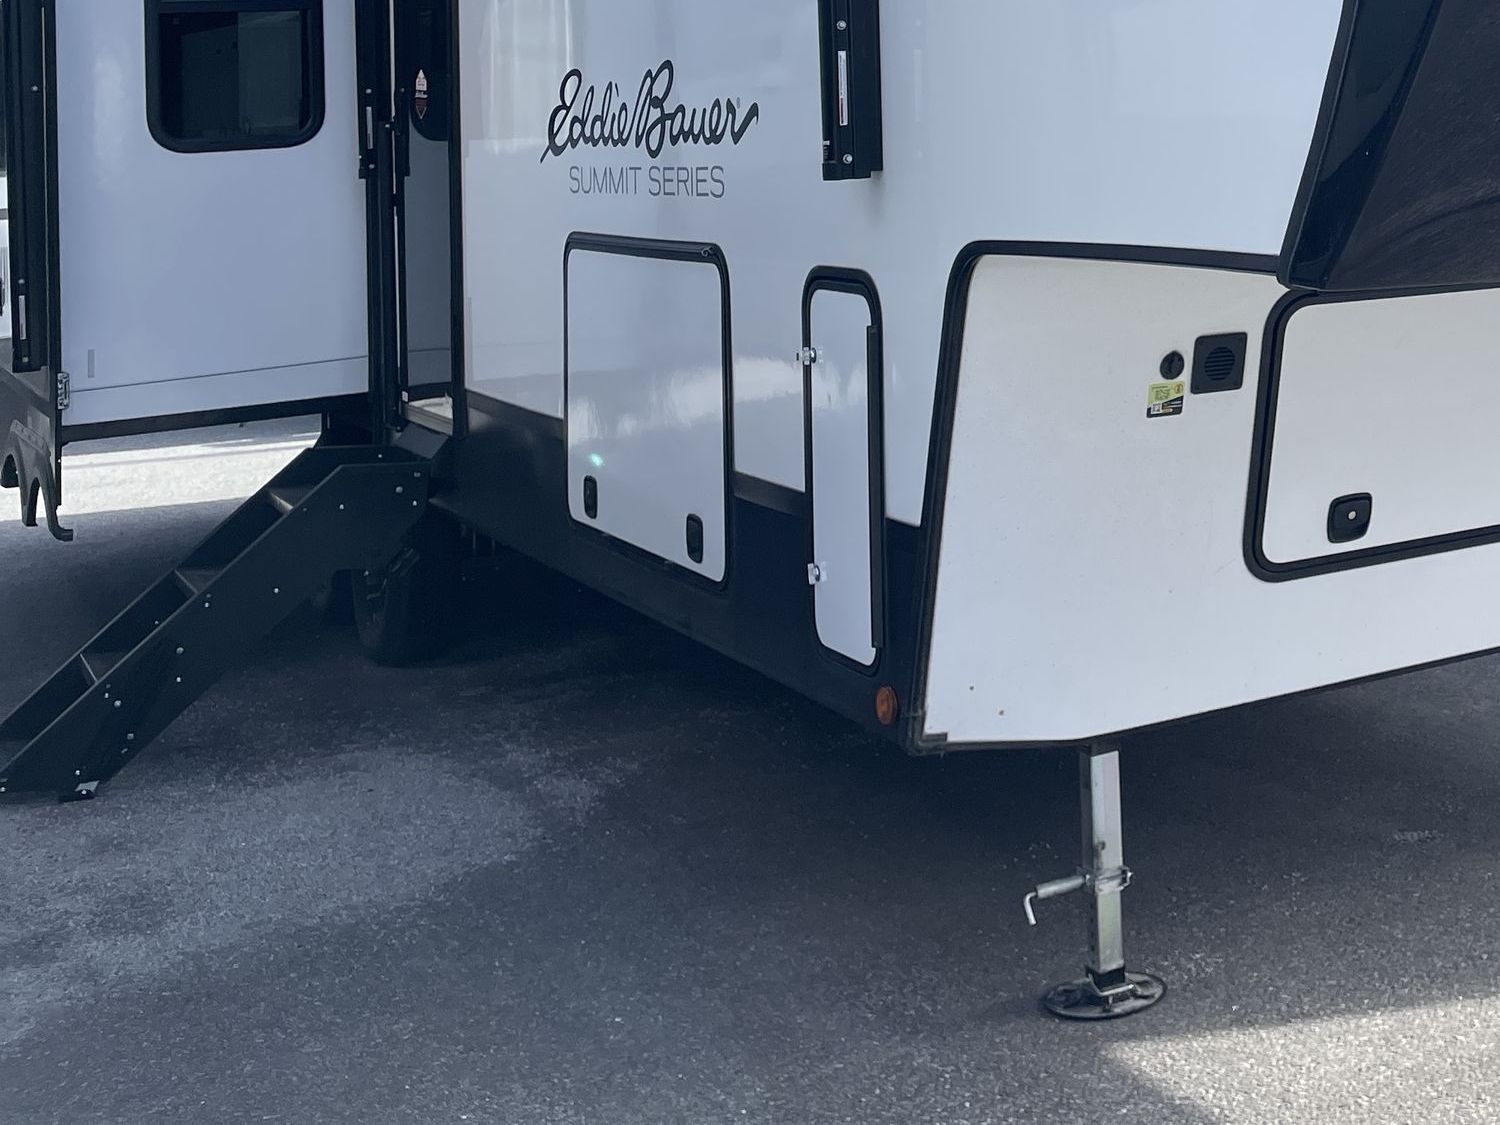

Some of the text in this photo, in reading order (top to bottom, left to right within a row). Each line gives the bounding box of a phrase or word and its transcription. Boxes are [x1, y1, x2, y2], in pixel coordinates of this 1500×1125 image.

[540, 68, 634, 163] Eddie
[632, 59, 759, 158] Bauer
[568, 165, 725, 198] SUMMIT SERIES
